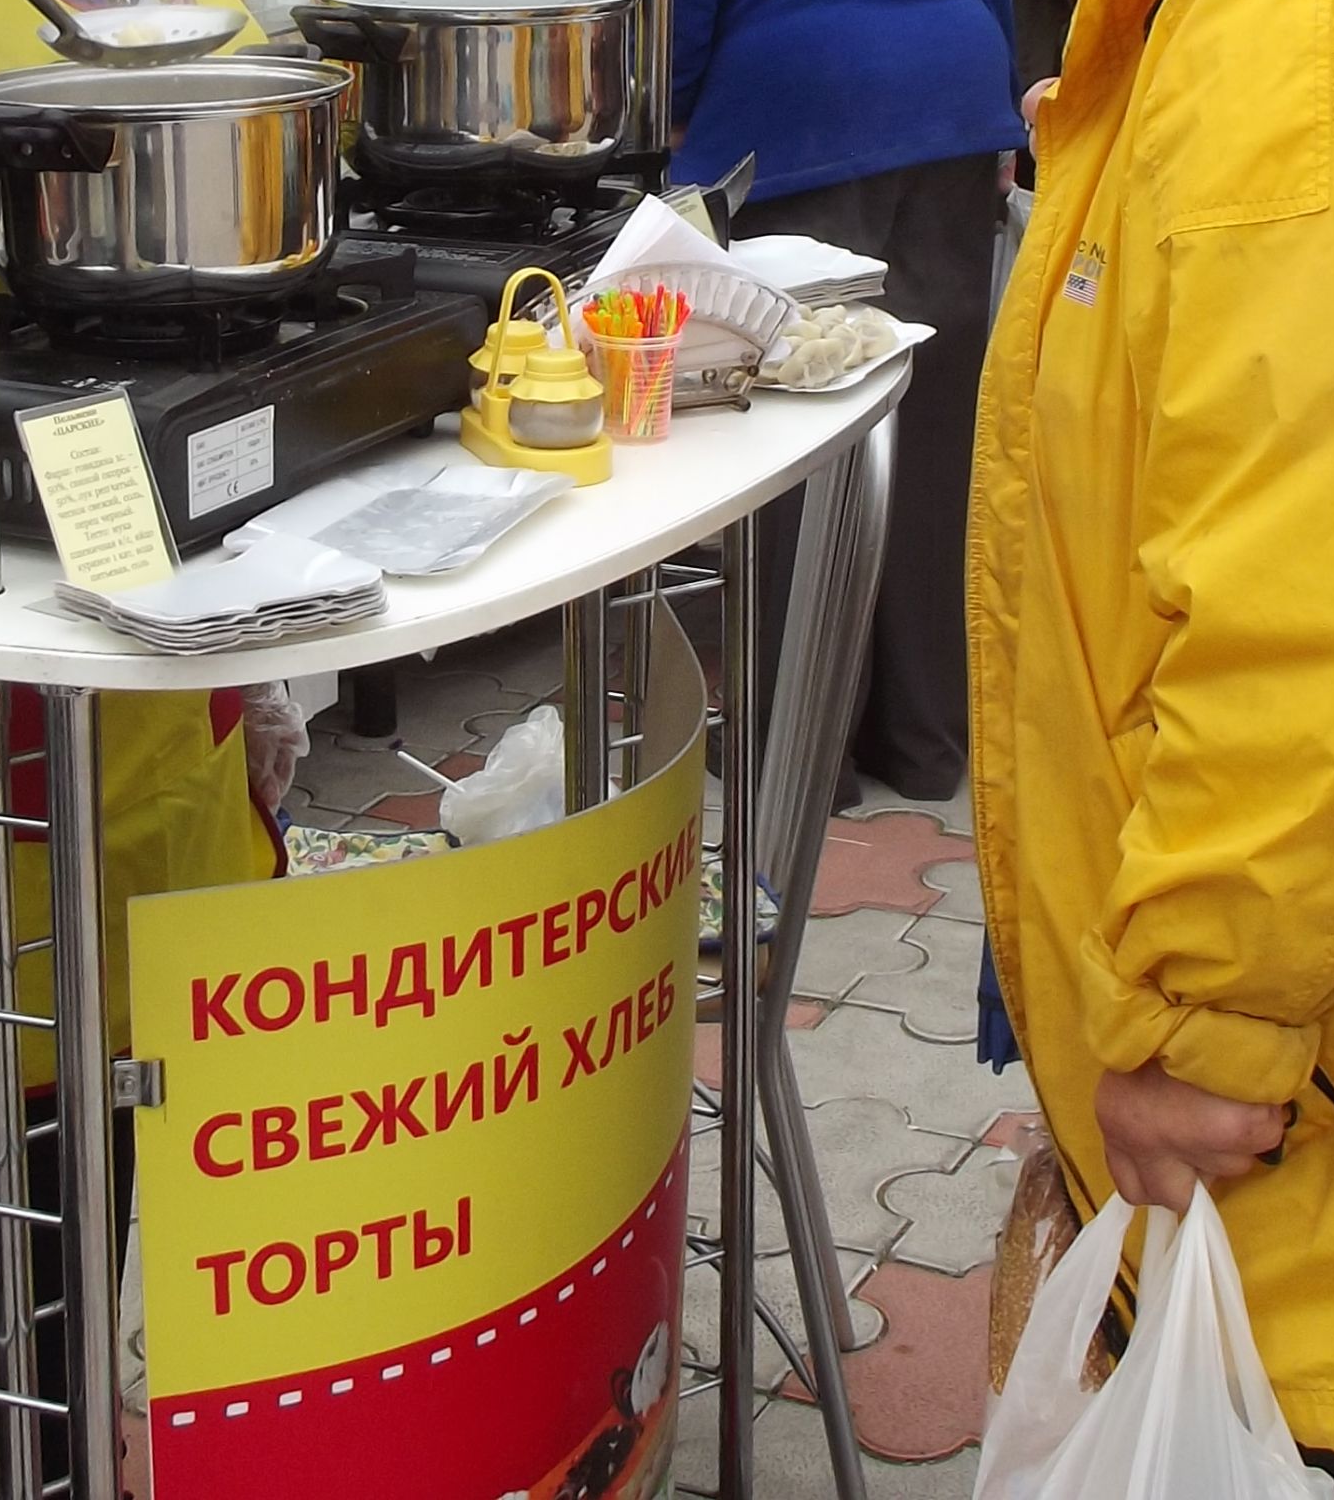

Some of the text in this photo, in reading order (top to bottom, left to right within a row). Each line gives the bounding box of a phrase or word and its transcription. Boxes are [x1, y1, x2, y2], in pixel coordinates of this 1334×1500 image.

[190, 814, 697, 1042] КОНДИТЕРСКИЕ
[192, 960, 675, 1179] СВЕЖИЙ ХЛЕБ
[196, 1196, 472, 1316] ТОРТЫ
